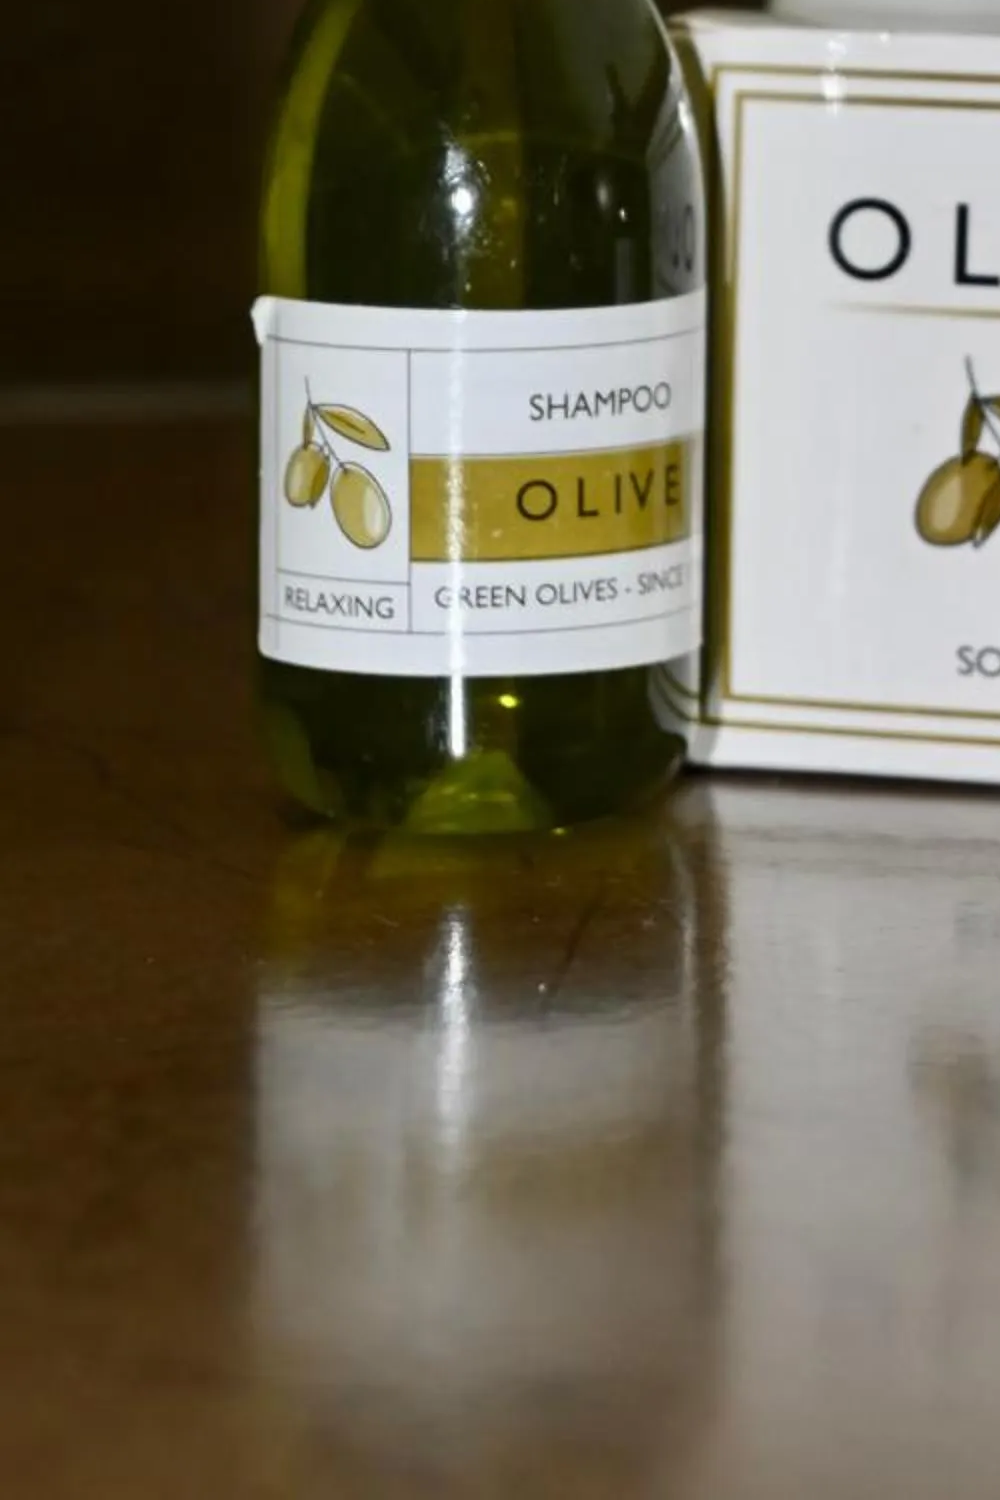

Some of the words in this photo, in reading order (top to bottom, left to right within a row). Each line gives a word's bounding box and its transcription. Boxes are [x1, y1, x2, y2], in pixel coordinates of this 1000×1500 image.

[529, 381, 672, 422] SHAMPOO
[516, 463, 681, 522] OLIVE
[285, 585, 395, 619] RELAXING
[434, 585, 526, 609] GREEN
[535, 577, 618, 606] OLIVES
